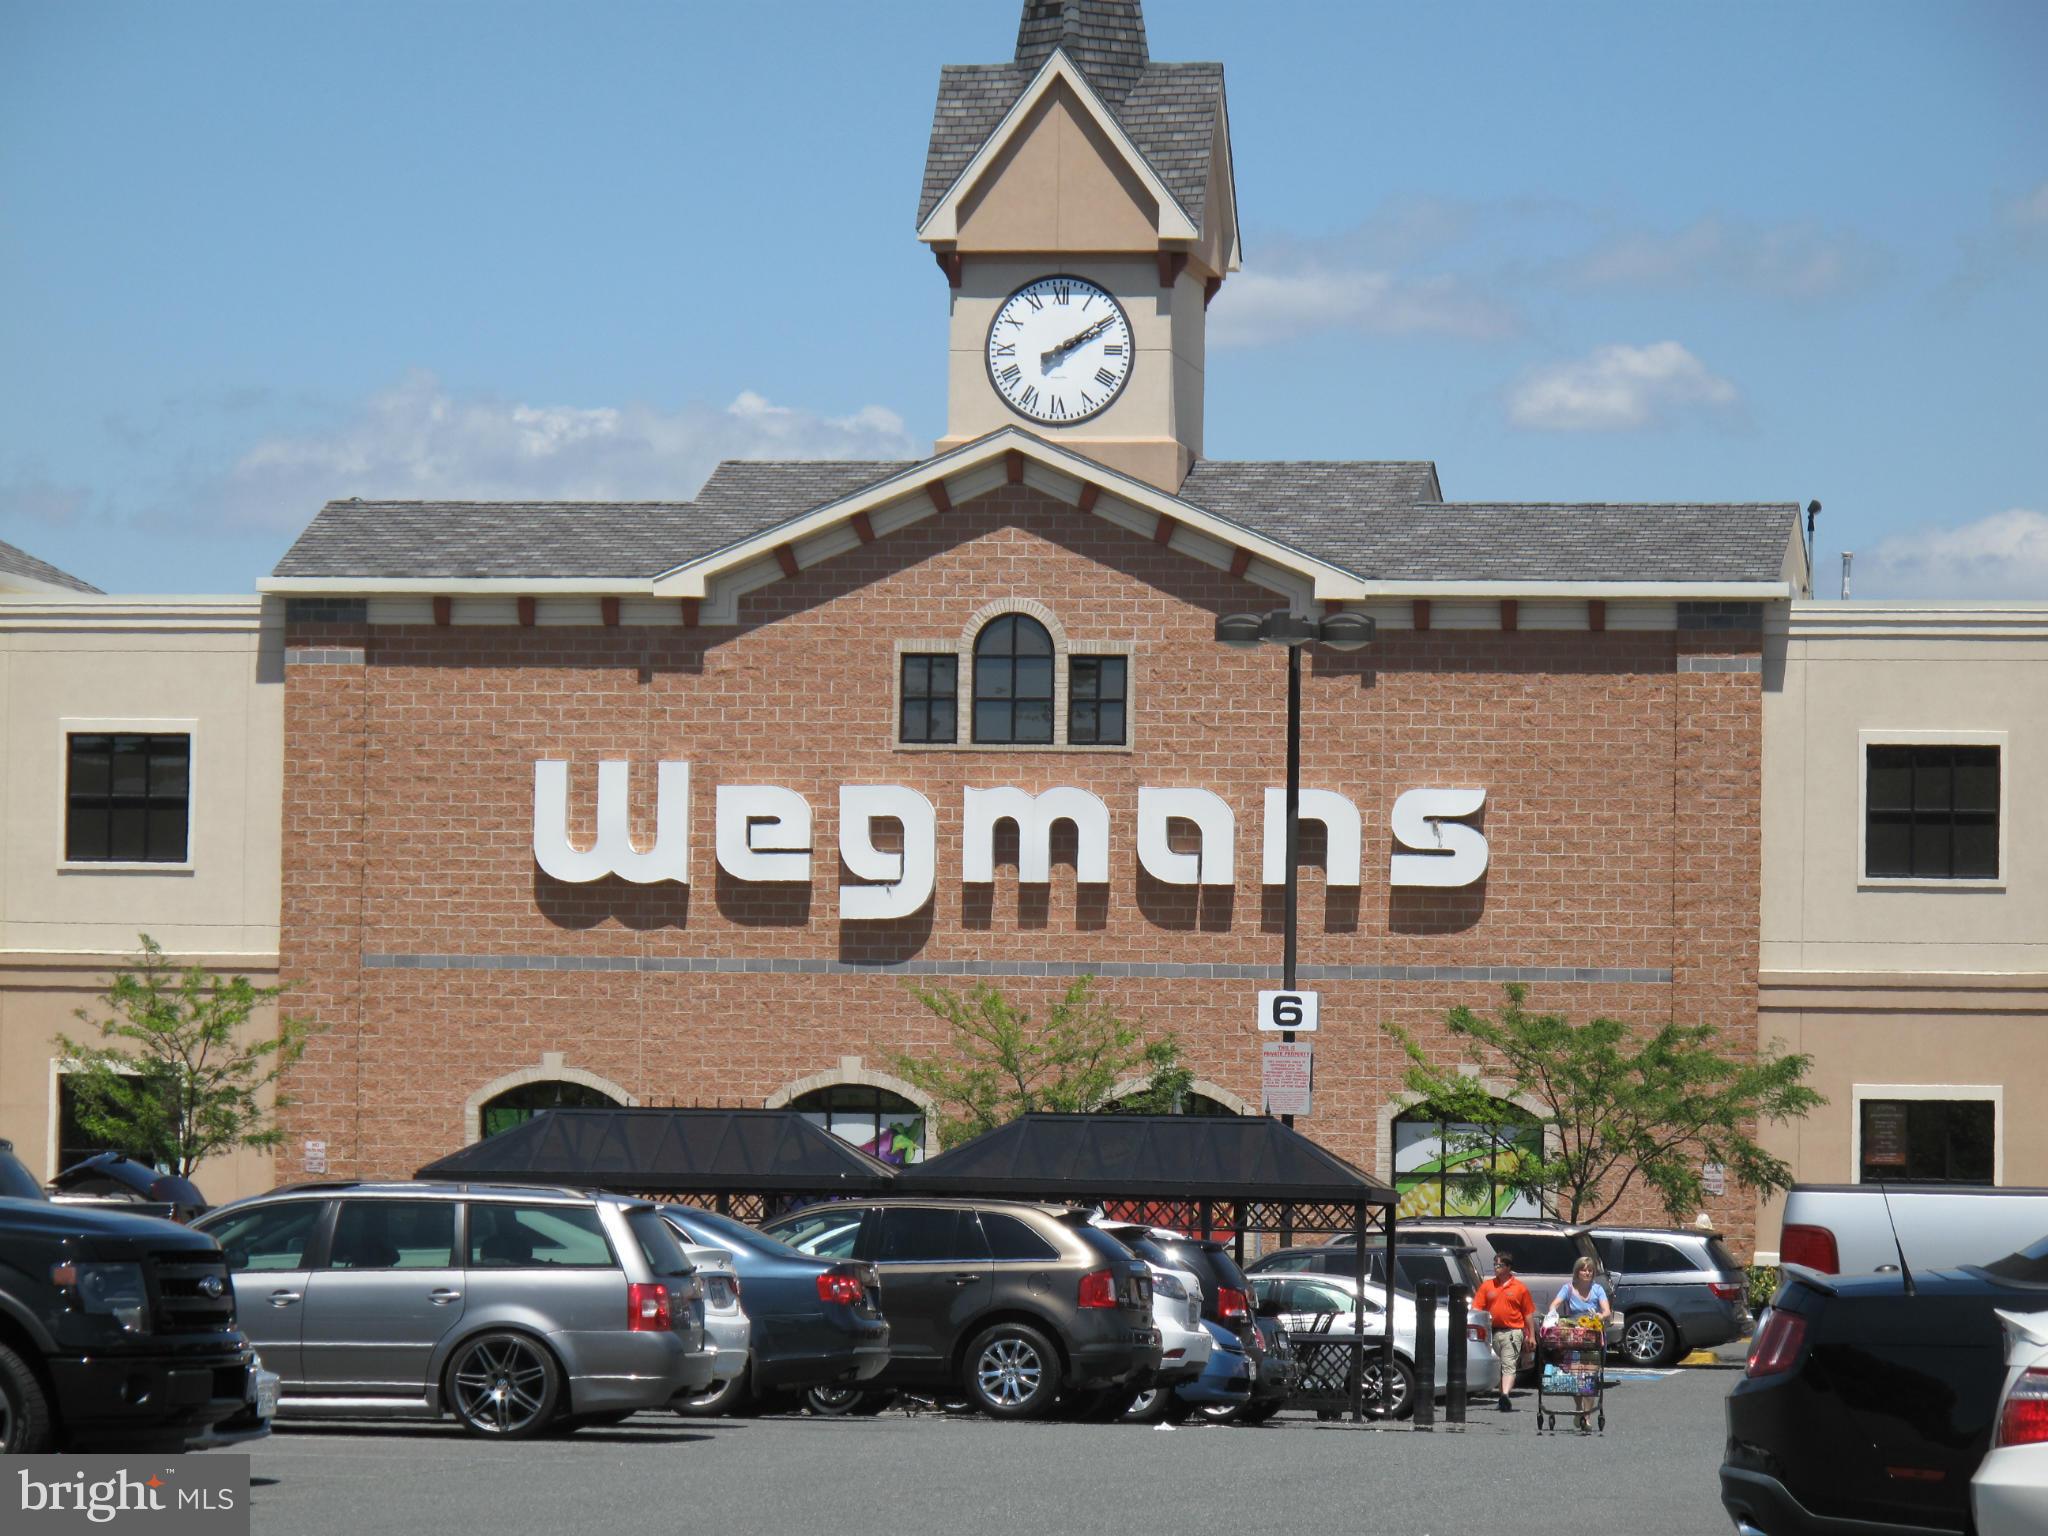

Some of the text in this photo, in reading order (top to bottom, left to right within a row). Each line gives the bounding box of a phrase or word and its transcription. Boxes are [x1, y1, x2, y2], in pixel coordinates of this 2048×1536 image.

[1025, 291, 1044, 314] XI
[1053, 286, 1069, 305] XII
[1004, 314, 1024, 331] X
[997, 343, 1015, 356] IX
[1104, 344, 1123, 355] III
[1000, 363, 1022, 390] VIII
[1020, 384, 1039, 409] VII
[1051, 394, 1065, 414] VI
[1081, 390, 1094, 408] V
[534, 759, 1489, 921] Wegmans
[1273, 996, 1303, 1026] 6
